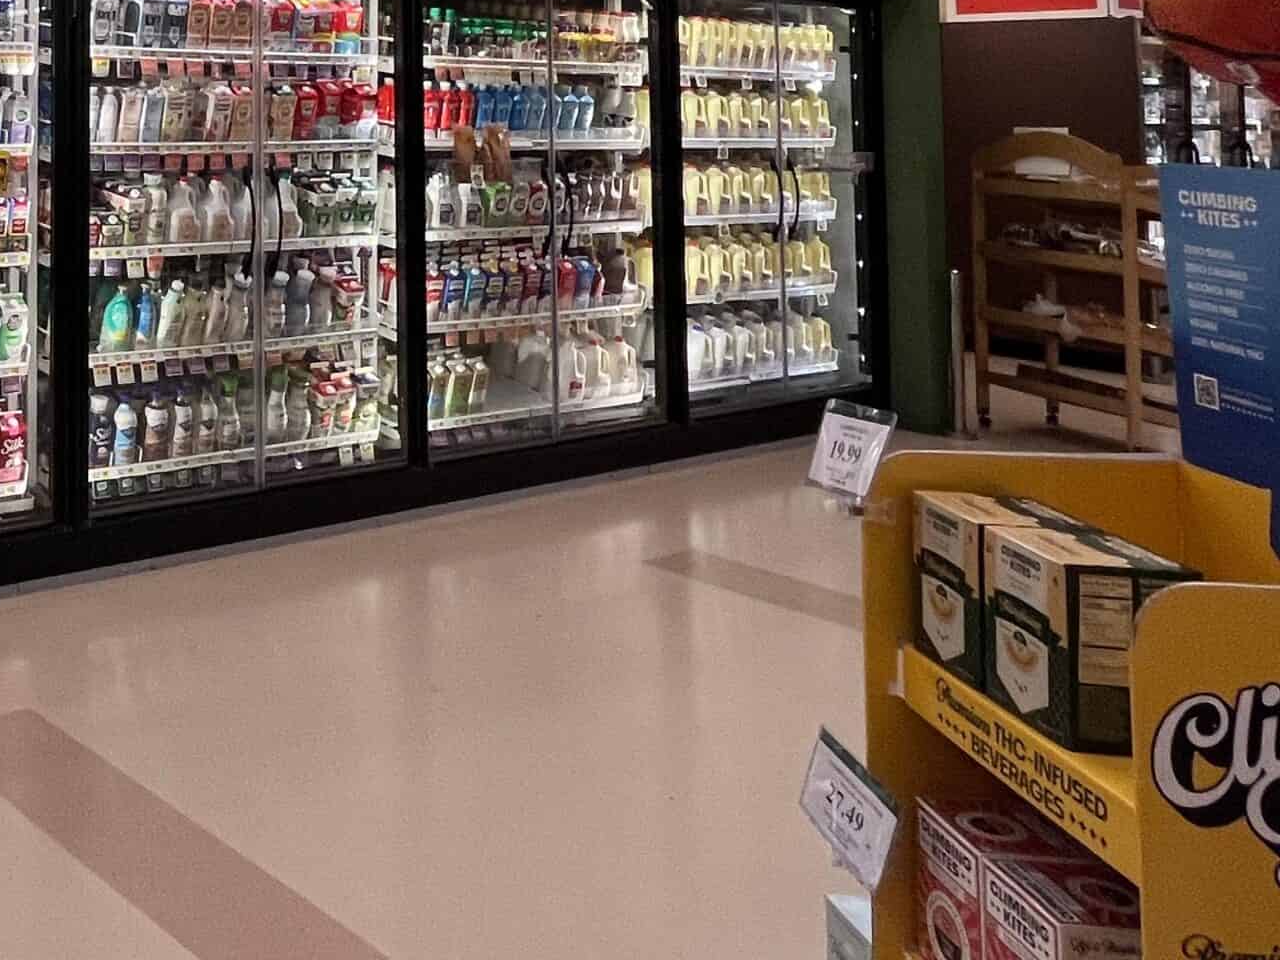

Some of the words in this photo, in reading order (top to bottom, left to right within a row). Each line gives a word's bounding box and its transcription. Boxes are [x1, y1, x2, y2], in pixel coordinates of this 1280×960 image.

[1178, 189, 1258, 213] CLIMBING
[1197, 209, 1242, 229] KITES
[1, 435, 25, 455] Silk
[829, 439, 863, 465] 19.99
[971, 732, 1065, 820] BEVERAGES
[994, 721, 1108, 823] THC-INFUSED
[824, 780, 866, 832] 27.49
[989, 880, 1050, 943] CLIMBING
[1002, 909, 1036, 949] KITES
